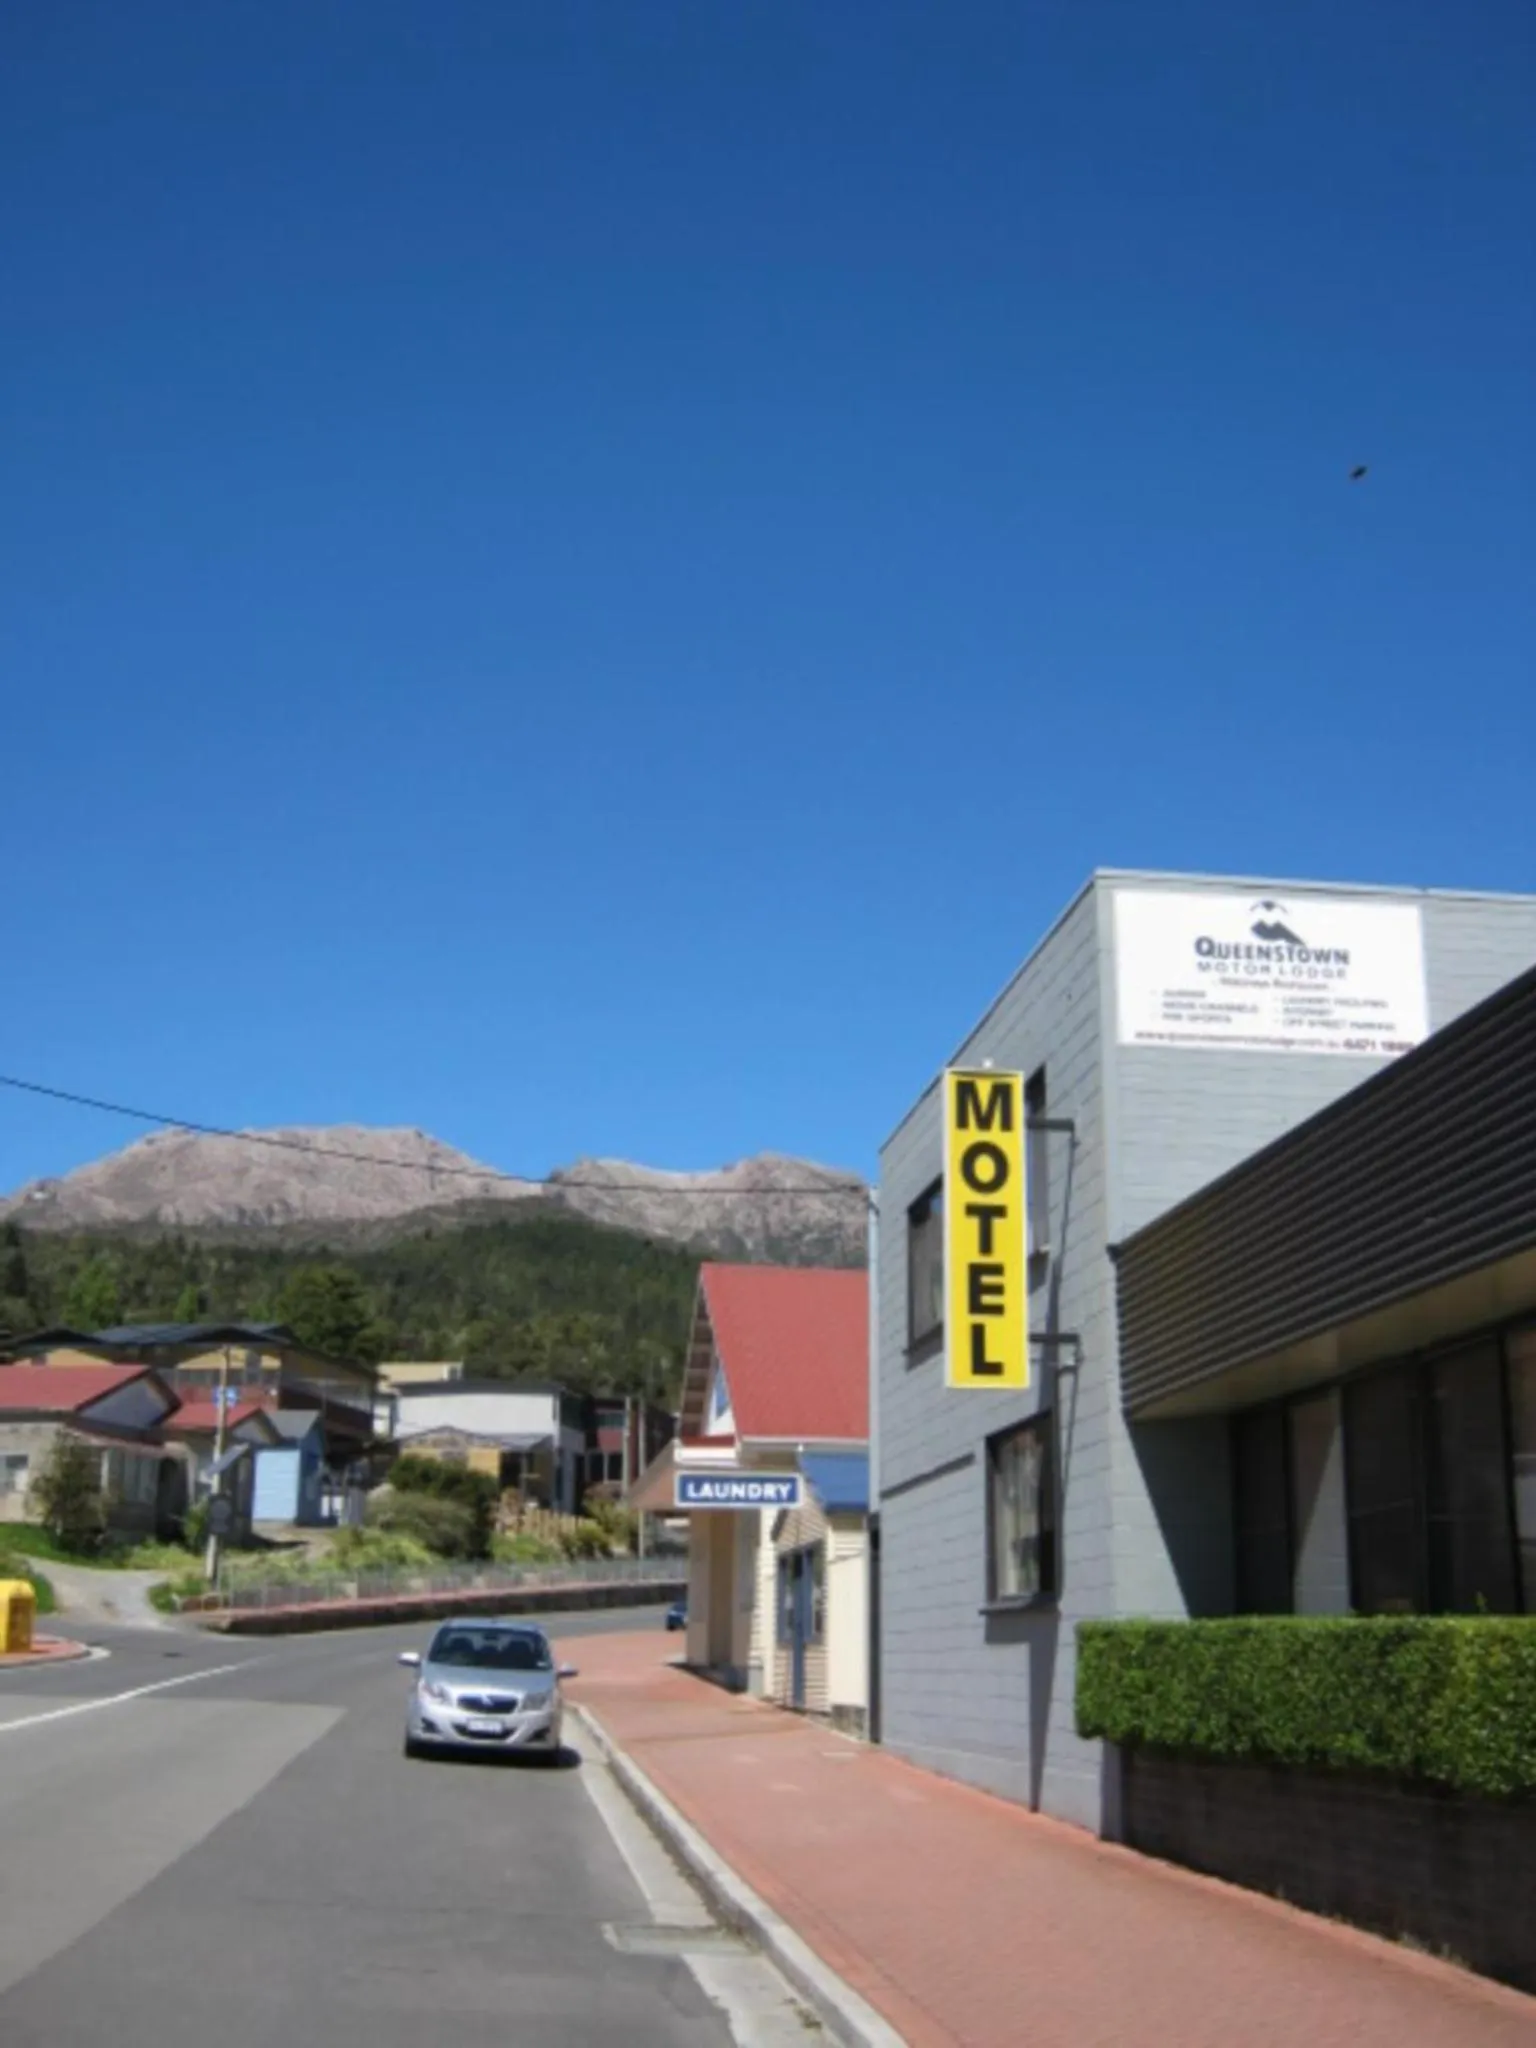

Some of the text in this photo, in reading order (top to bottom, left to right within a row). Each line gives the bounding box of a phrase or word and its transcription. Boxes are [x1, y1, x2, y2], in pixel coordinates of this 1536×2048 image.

[1197, 961, 1346, 980] MOTOR LODGE
[955, 1080, 1014, 1376] MOTEL
[686, 1481, 792, 1500] LAUNDRY
